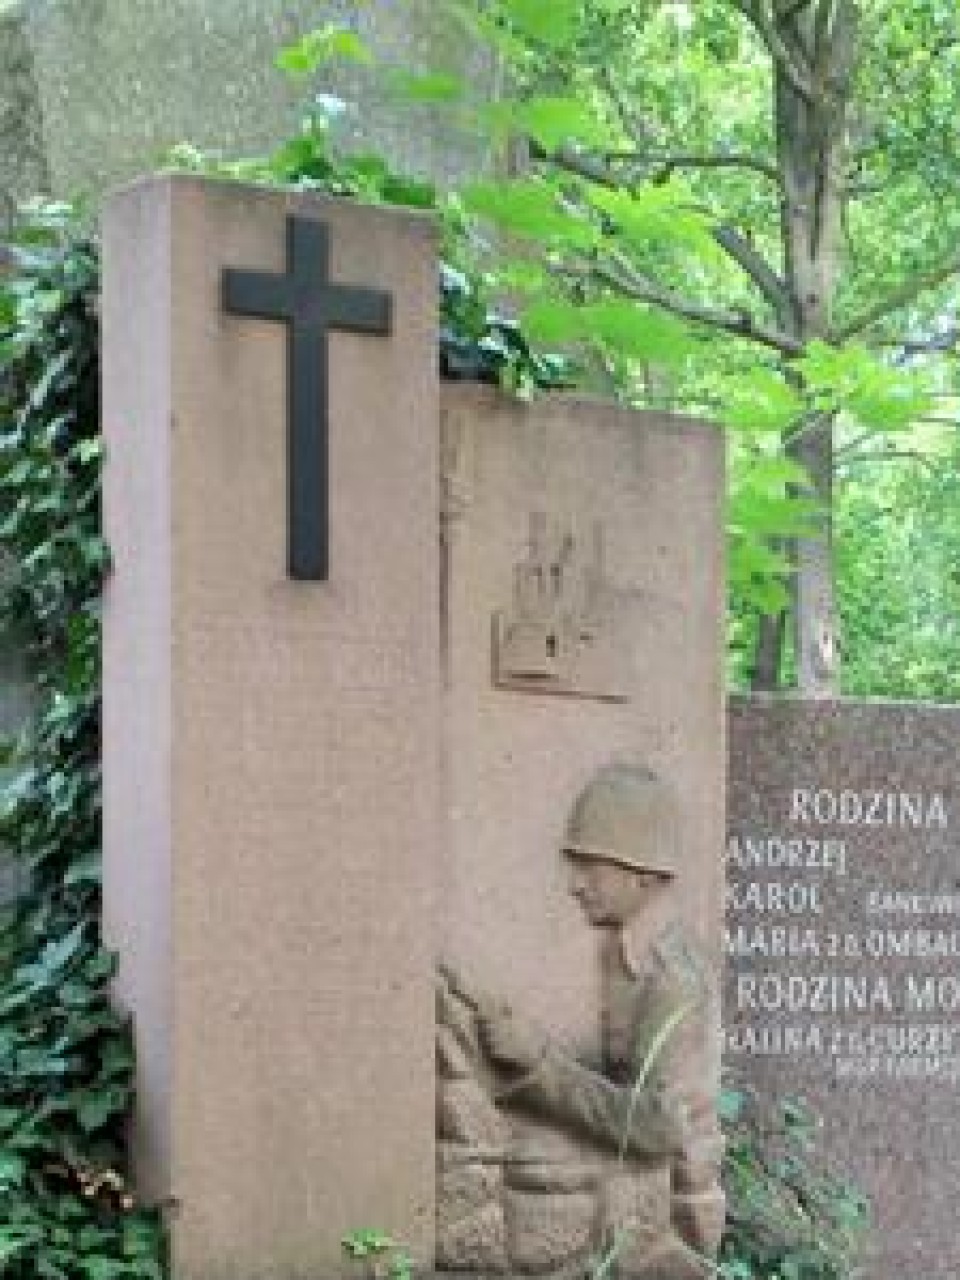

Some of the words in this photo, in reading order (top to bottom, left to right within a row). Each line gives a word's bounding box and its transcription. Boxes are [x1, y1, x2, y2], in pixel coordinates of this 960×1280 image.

[791, 788, 948, 827] RODZINA
[726, 837, 846, 875] ANDRZEJ
[726, 882, 823, 914] KAROL
[735, 976, 890, 1012] RODZINA
